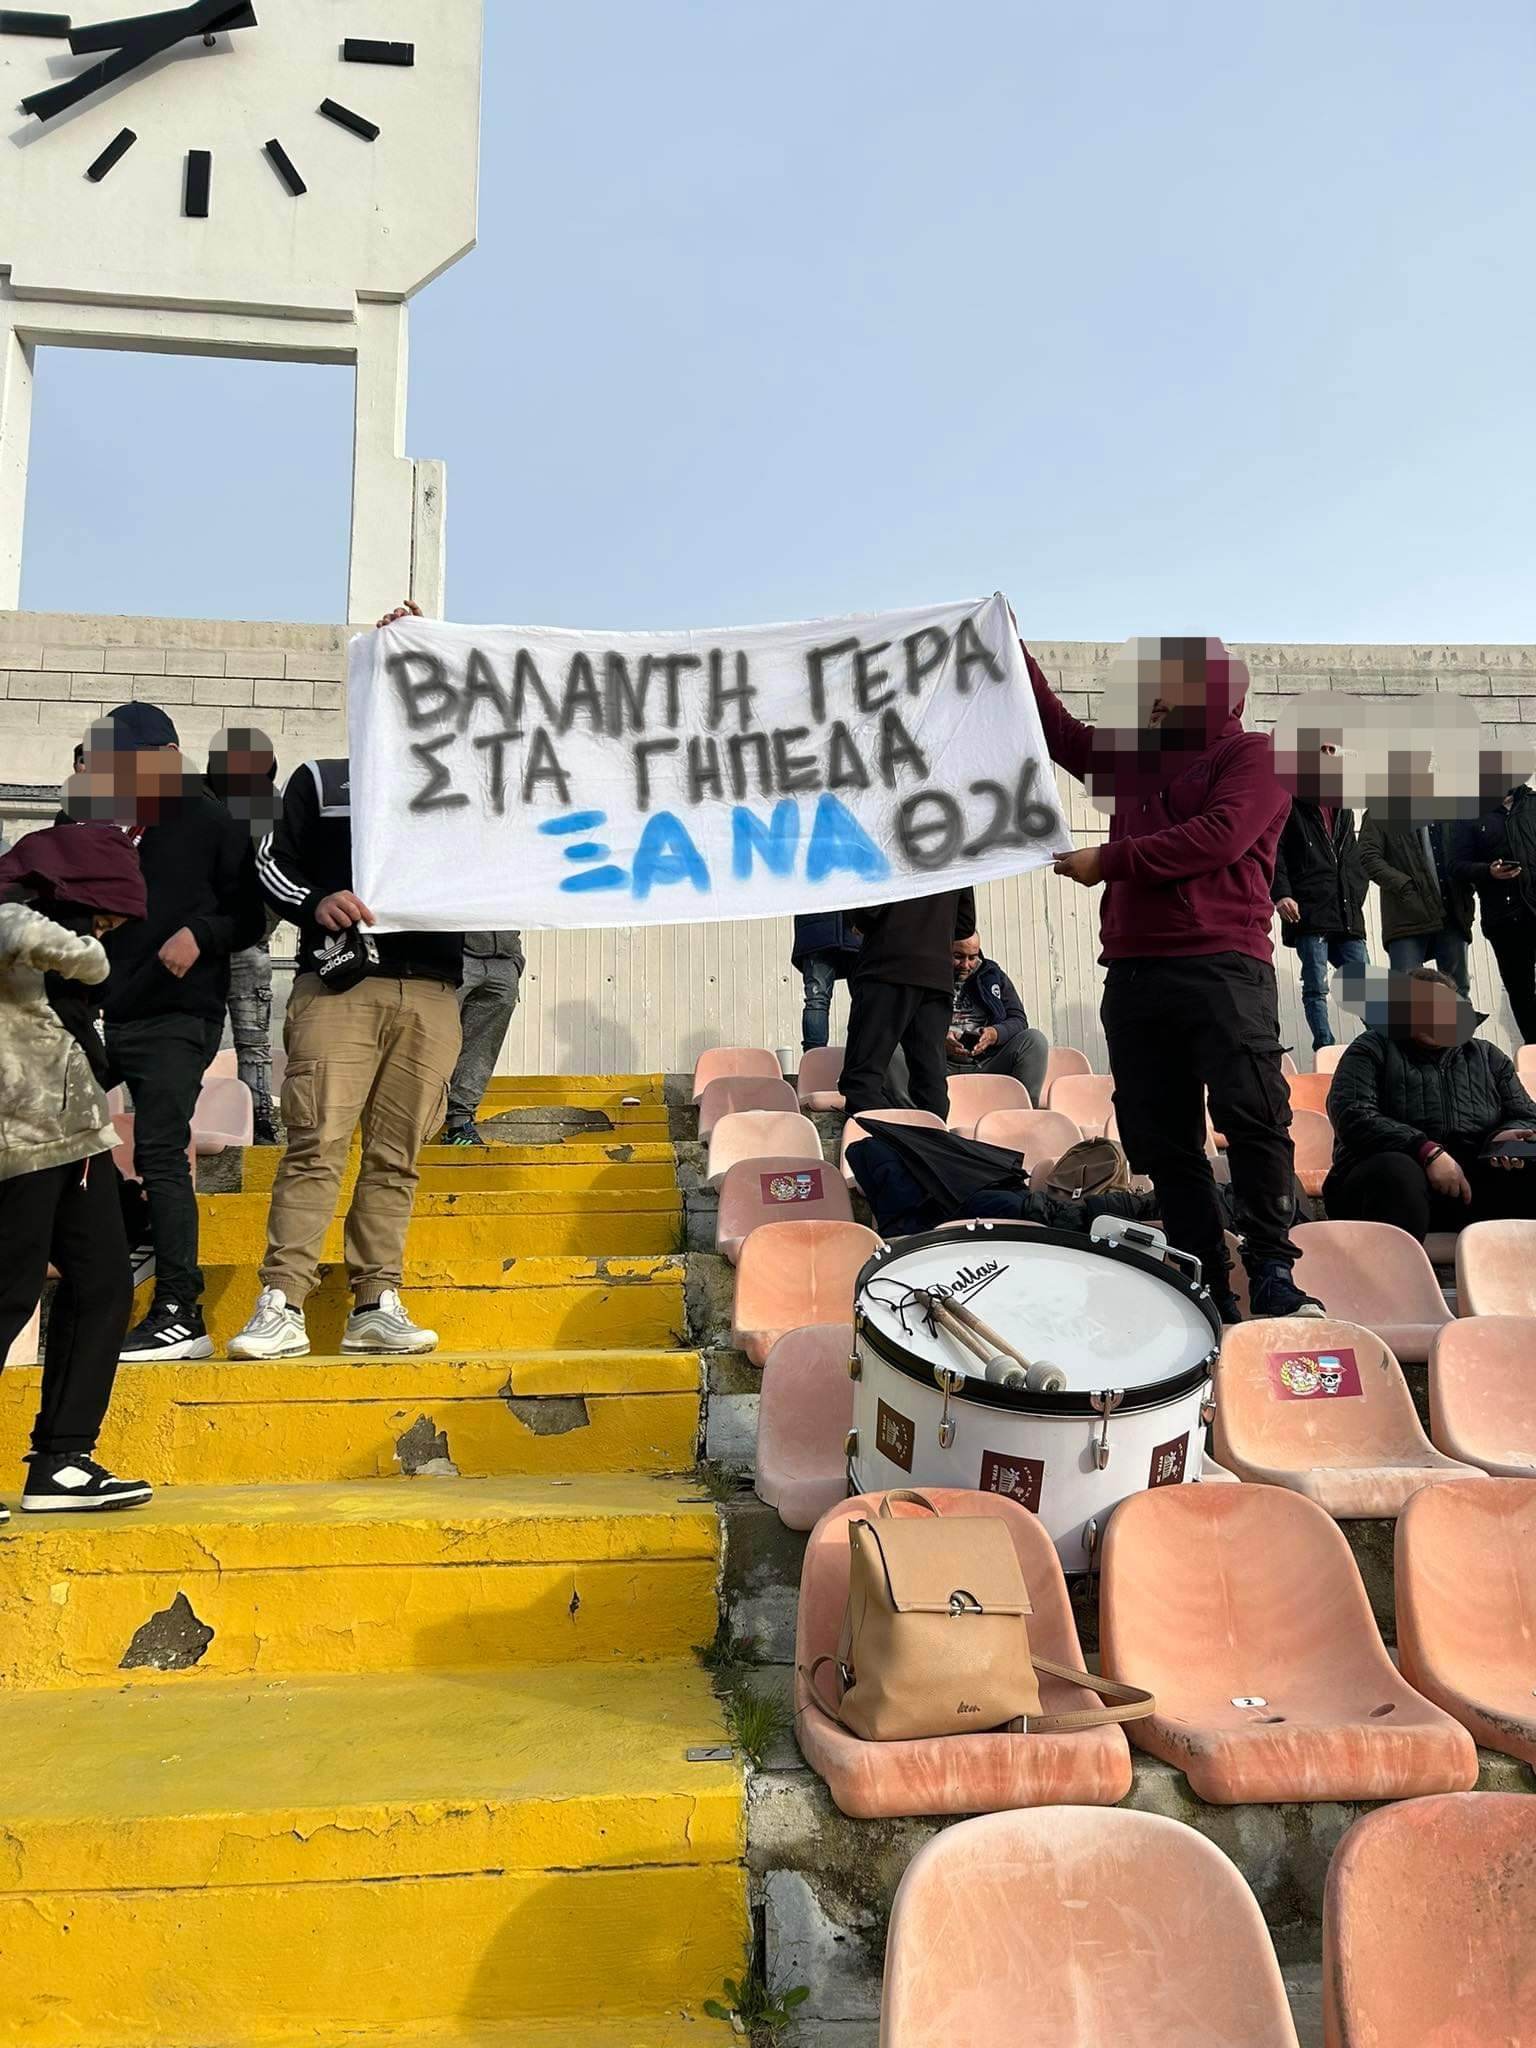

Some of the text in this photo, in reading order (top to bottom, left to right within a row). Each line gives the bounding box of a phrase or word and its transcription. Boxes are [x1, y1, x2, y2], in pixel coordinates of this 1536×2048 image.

[386, 618, 1006, 736] ΒΑΛΑΝΤΗ ΓΕΡΑ
[409, 707, 931, 815] ΣΤΑ ΓΗΠΕΔΑ
[895, 757, 1059, 871] Θ26
[537, 793, 891, 902] ΞΑΝΑ
[319, 950, 355, 976] adidas
[926, 1259, 998, 1298] Dallas
[1243, 1698, 1255, 1706] 2
